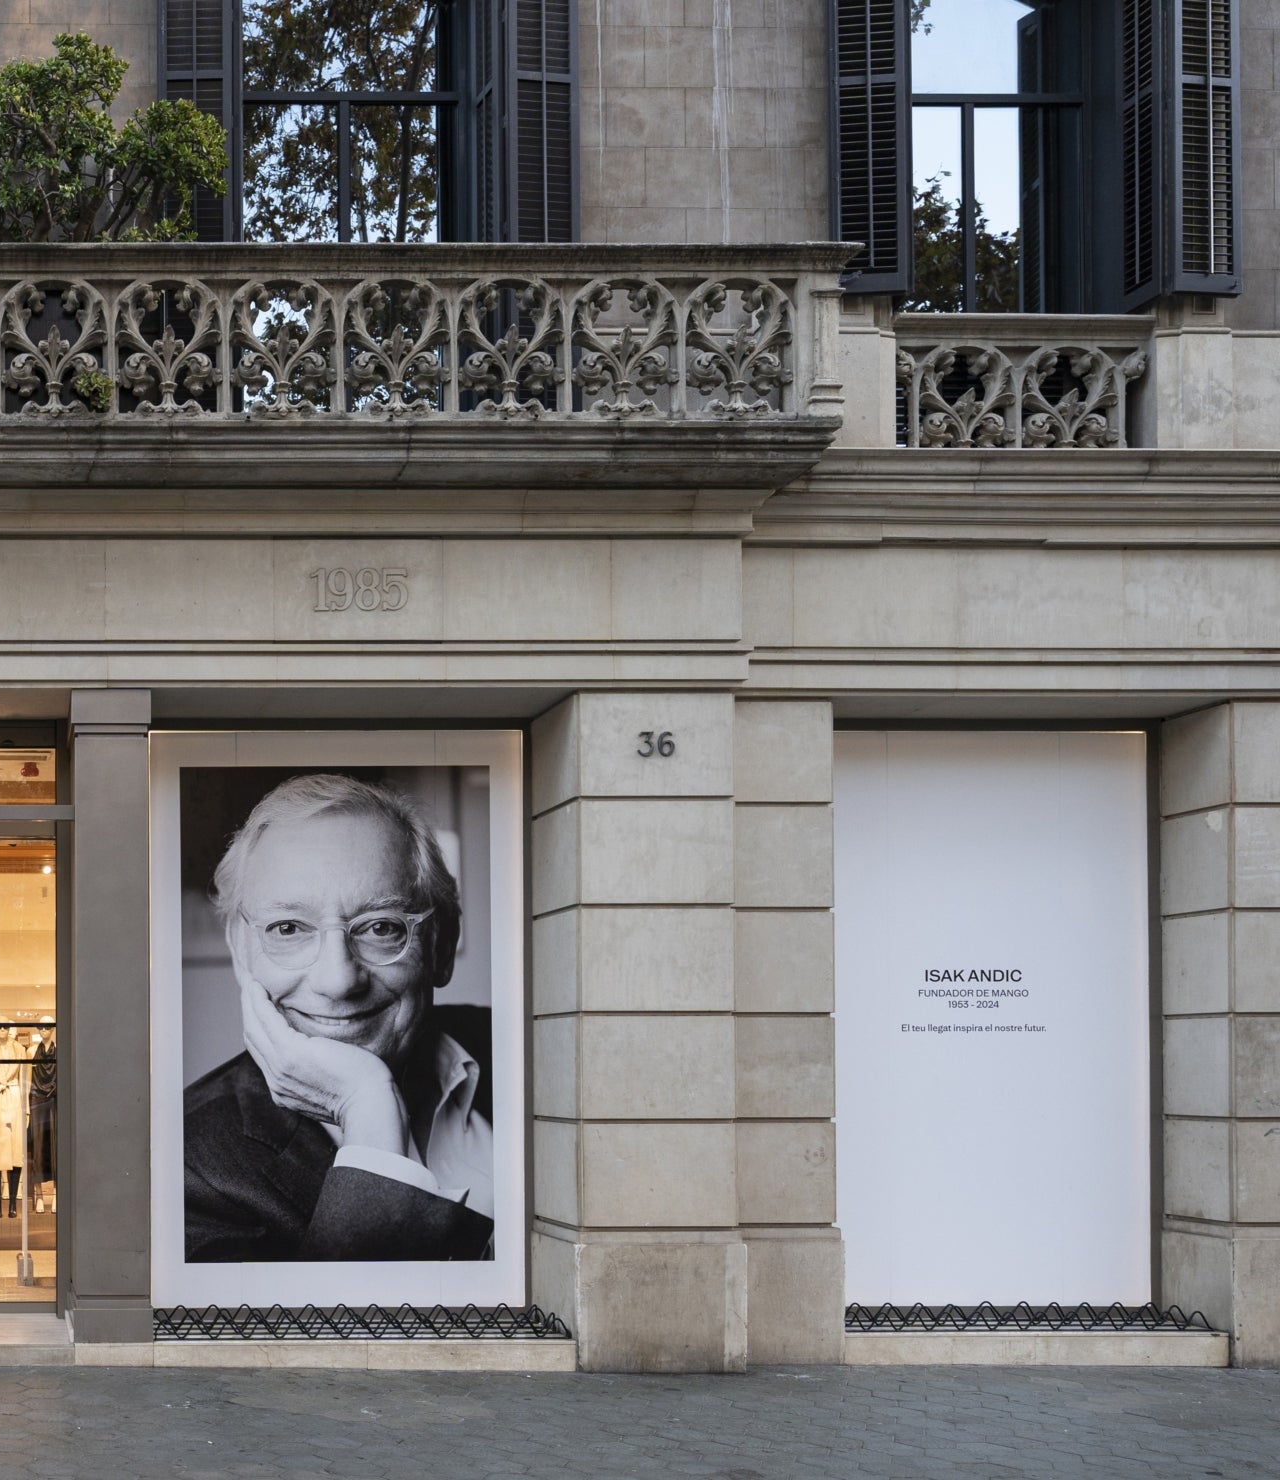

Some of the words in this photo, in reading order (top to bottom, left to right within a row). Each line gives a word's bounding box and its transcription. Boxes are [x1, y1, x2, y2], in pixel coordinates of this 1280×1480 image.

[310, 567, 409, 612] 1985
[636, 731, 676, 758] 36
[924, 969, 965, 983] ISAK
[968, 969, 1023, 983] ANDIC
[918, 989, 974, 998] FUNDADOR
[976, 989, 990, 998] DE
[991, 989, 1030, 998] MANGO
[948, 1000, 969, 1009] 1953
[976, 1000, 1000, 1009] 2024
[901, 1024, 910, 1032] El
[912, 1024, 926, 1032] teu
[927, 1024, 952, 1034] llegat
[953, 1024, 983, 1034] inspira
[984, 1024, 993, 1032] el
[994, 1024, 1023, 1032] nostre
[1024, 1024, 1047, 1032] futur.
